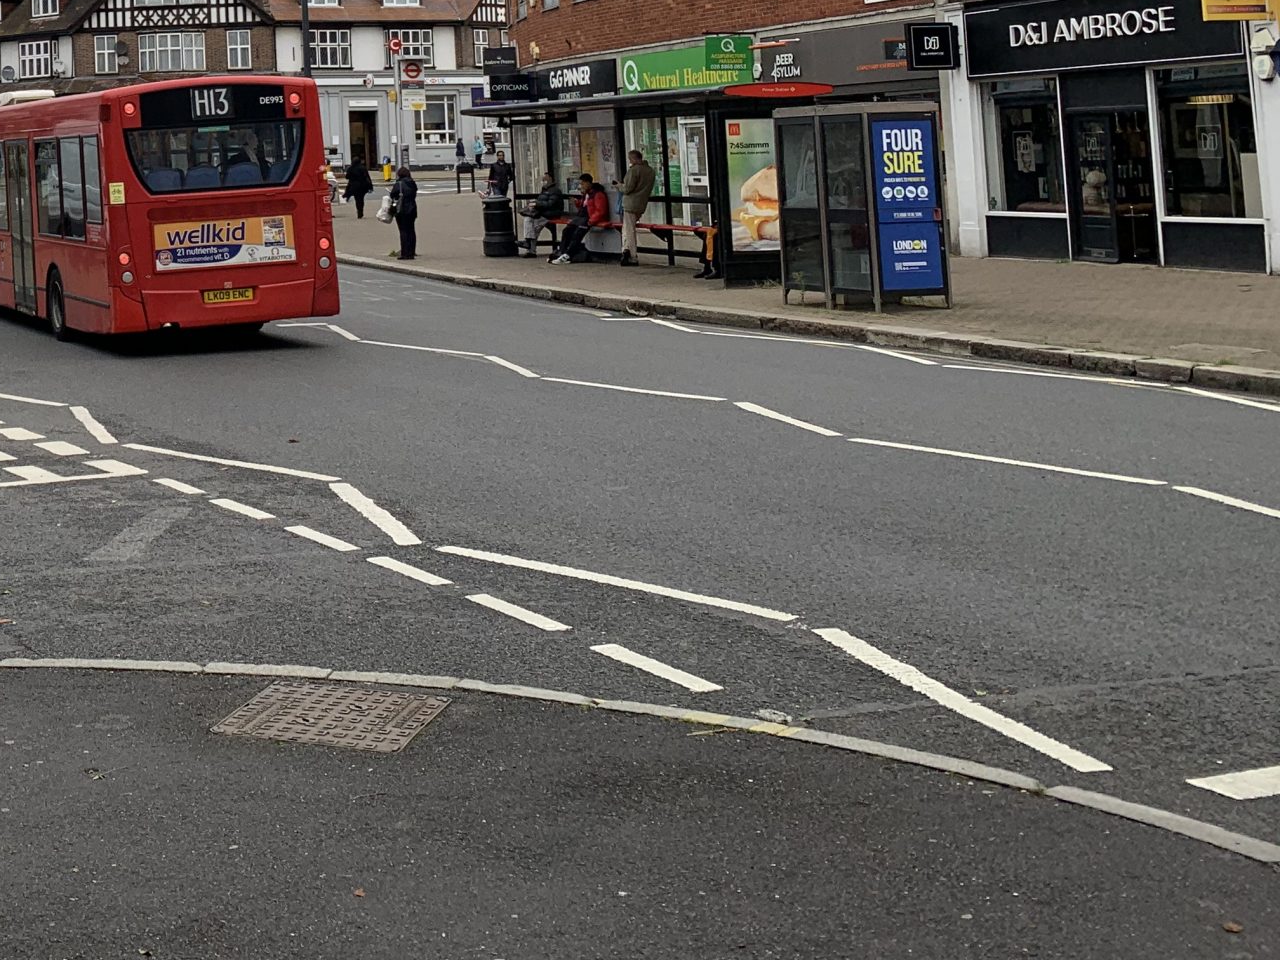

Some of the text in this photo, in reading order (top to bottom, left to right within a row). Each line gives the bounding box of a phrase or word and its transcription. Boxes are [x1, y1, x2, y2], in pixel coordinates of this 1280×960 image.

[1054, 6, 1176, 42] AMBROSE
[776, 53, 793, 65] BEER
[563, 65, 591, 87] PINNER
[643, 69, 680, 89] Natural
[683, 65, 739, 86] Healthcare
[492, 83, 528, 92] OPTICIANS
[195, 88, 284, 116] H13 DE993
[882, 129, 923, 151] FOUR
[883, 151, 924, 174] SURE
[167, 222, 245, 246] wellkid
[177, 248, 185, 256] 21
[186, 246, 218, 256] nutrients
[207, 289, 250, 301] LK09 ENC
